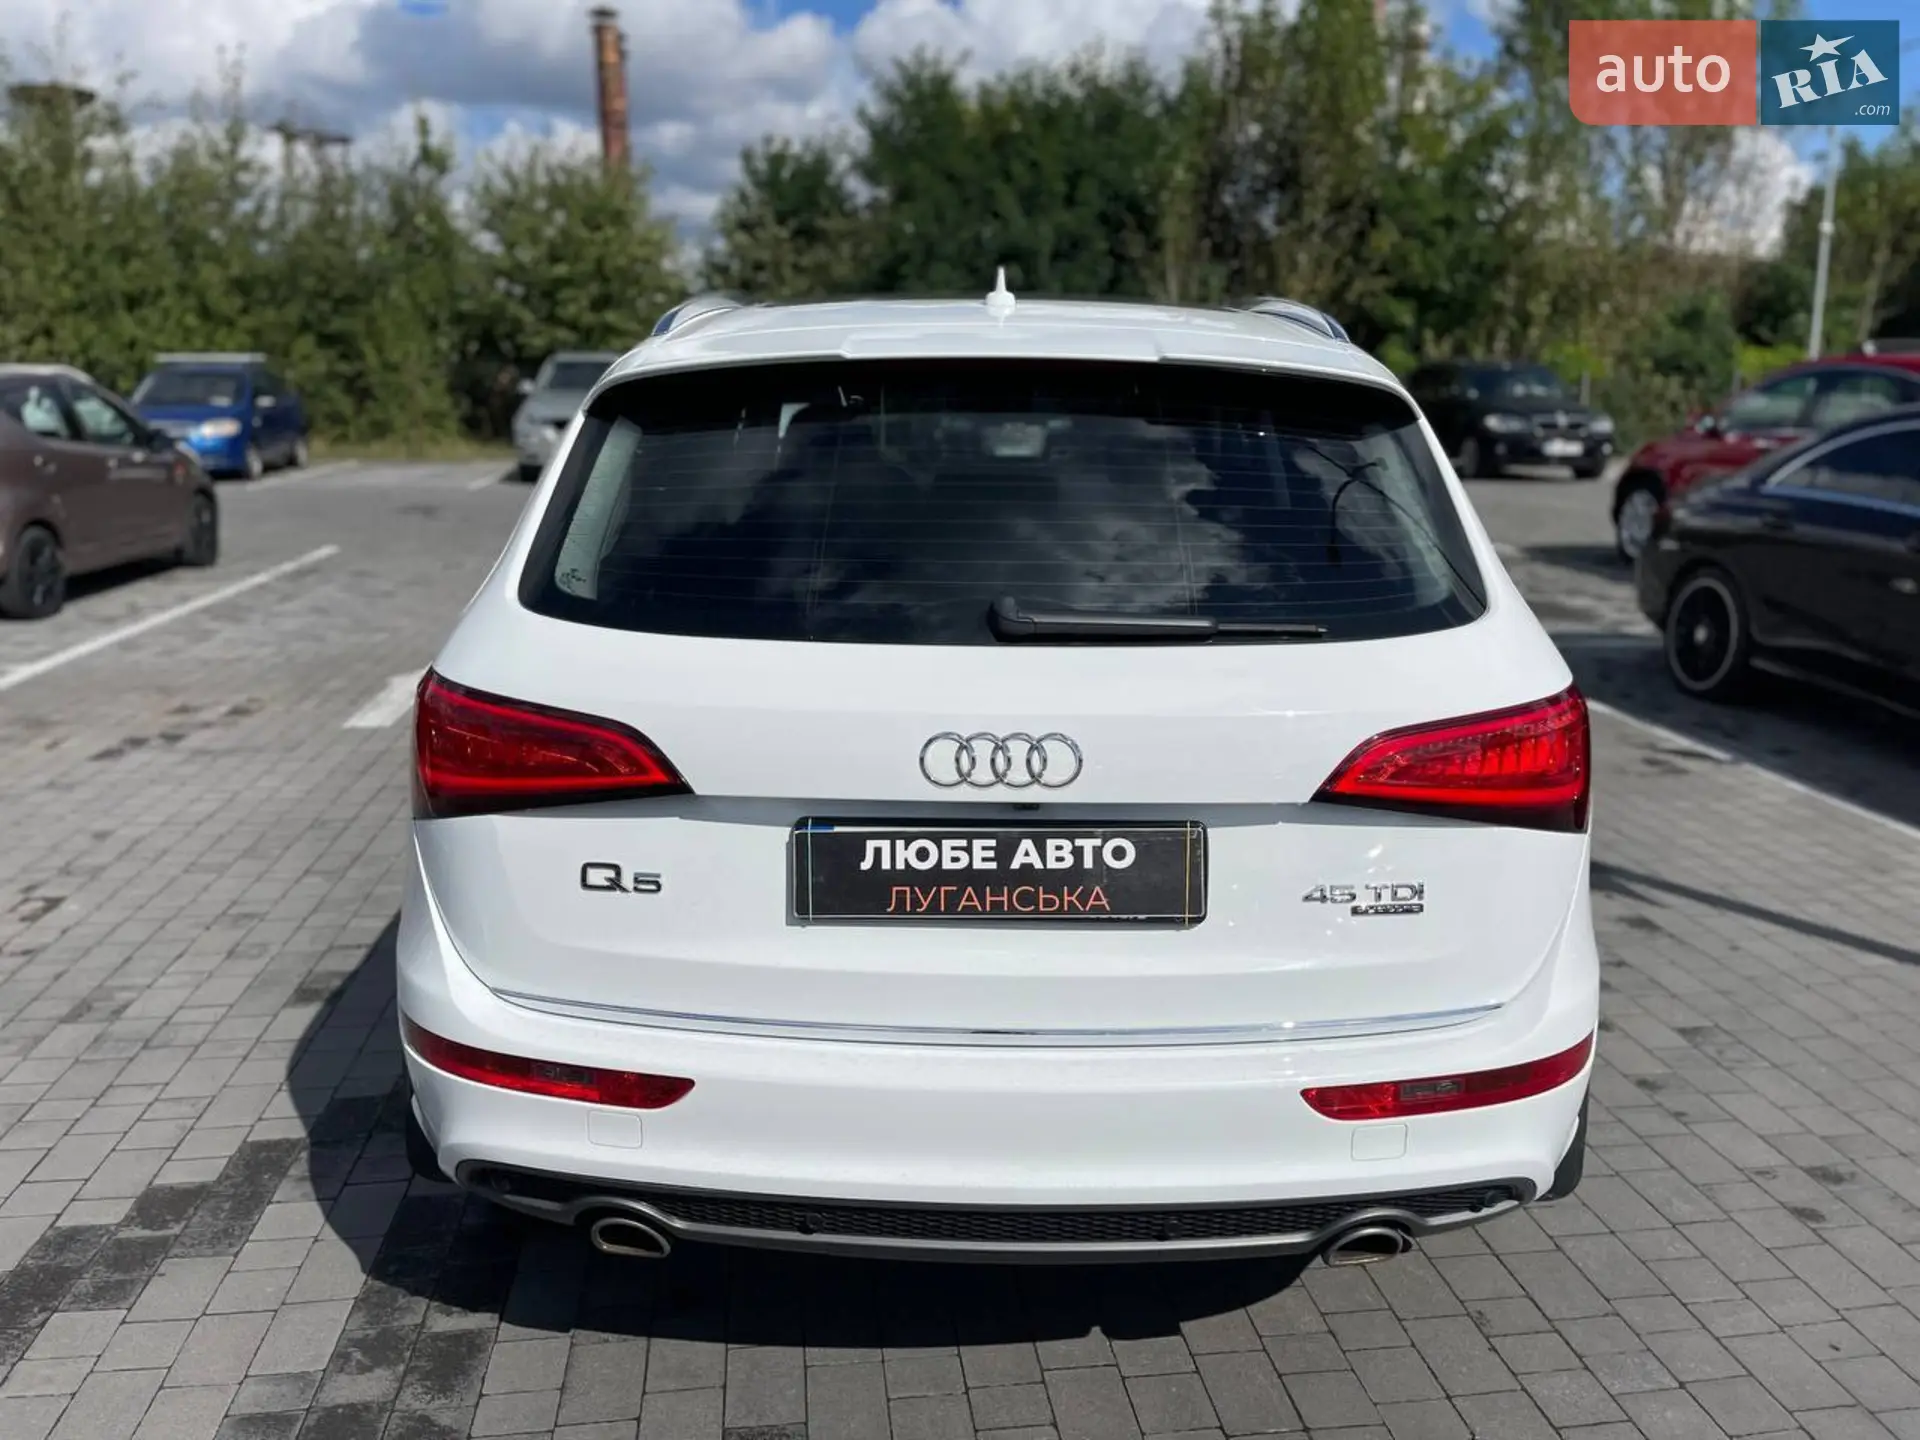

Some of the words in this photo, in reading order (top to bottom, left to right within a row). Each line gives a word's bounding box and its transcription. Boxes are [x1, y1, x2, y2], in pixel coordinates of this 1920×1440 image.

[859, 838, 998, 871] ЛЮБЕ
[1009, 837, 1137, 870] АВТО
[580, 861, 662, 894] Q5
[887, 885, 1111, 913] ЛУГАНСЬКА
[1302, 884, 1357, 904] 45
